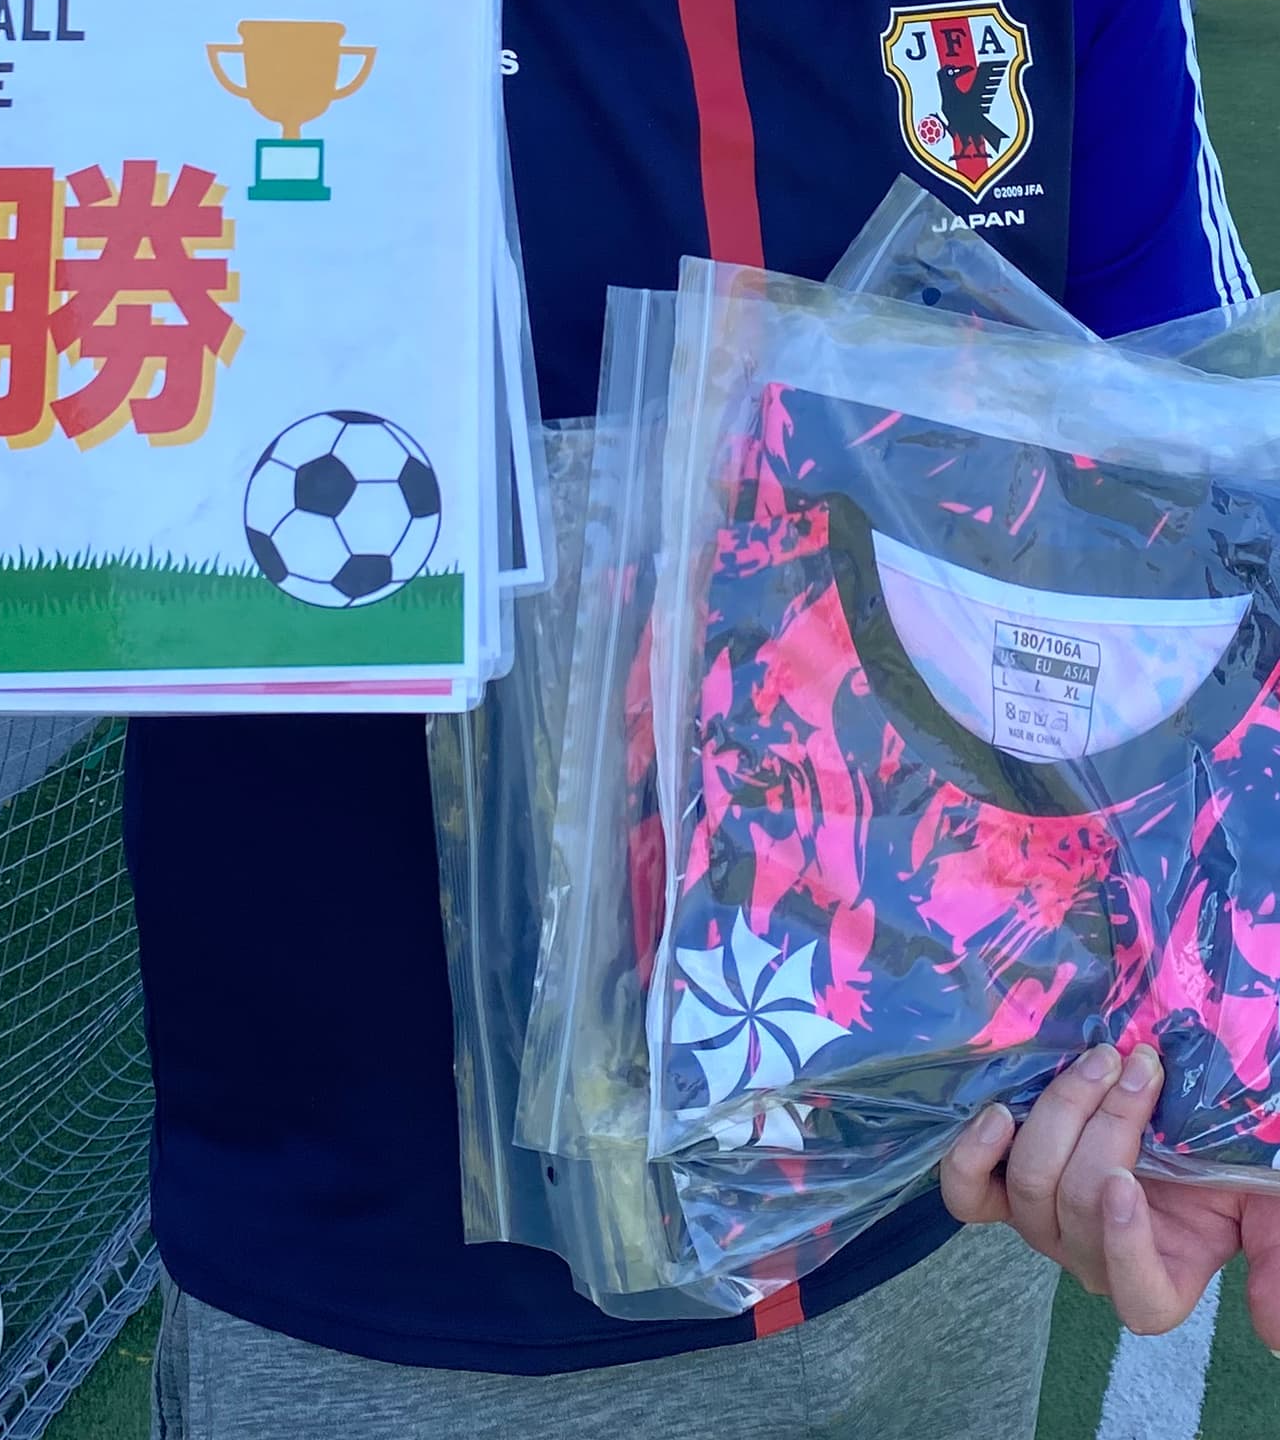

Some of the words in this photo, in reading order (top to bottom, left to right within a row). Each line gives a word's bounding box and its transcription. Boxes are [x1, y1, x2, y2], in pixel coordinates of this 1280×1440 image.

[905, 25, 1006, 61] JFA
[1024, 183, 1045, 196] JFA
[932, 209, 1025, 233] JAPAN
[1013, 630, 1081, 659] 180/106A
[1000, 651, 1016, 665] US
[1035, 658, 1052, 673] EU
[1063, 664, 1090, 682] ASIA
[1001, 671, 1008, 686] L
[1034, 679, 1041, 693] L
[1063, 685, 1080, 700] XL
[1037, 733, 1061, 746] CHINA
